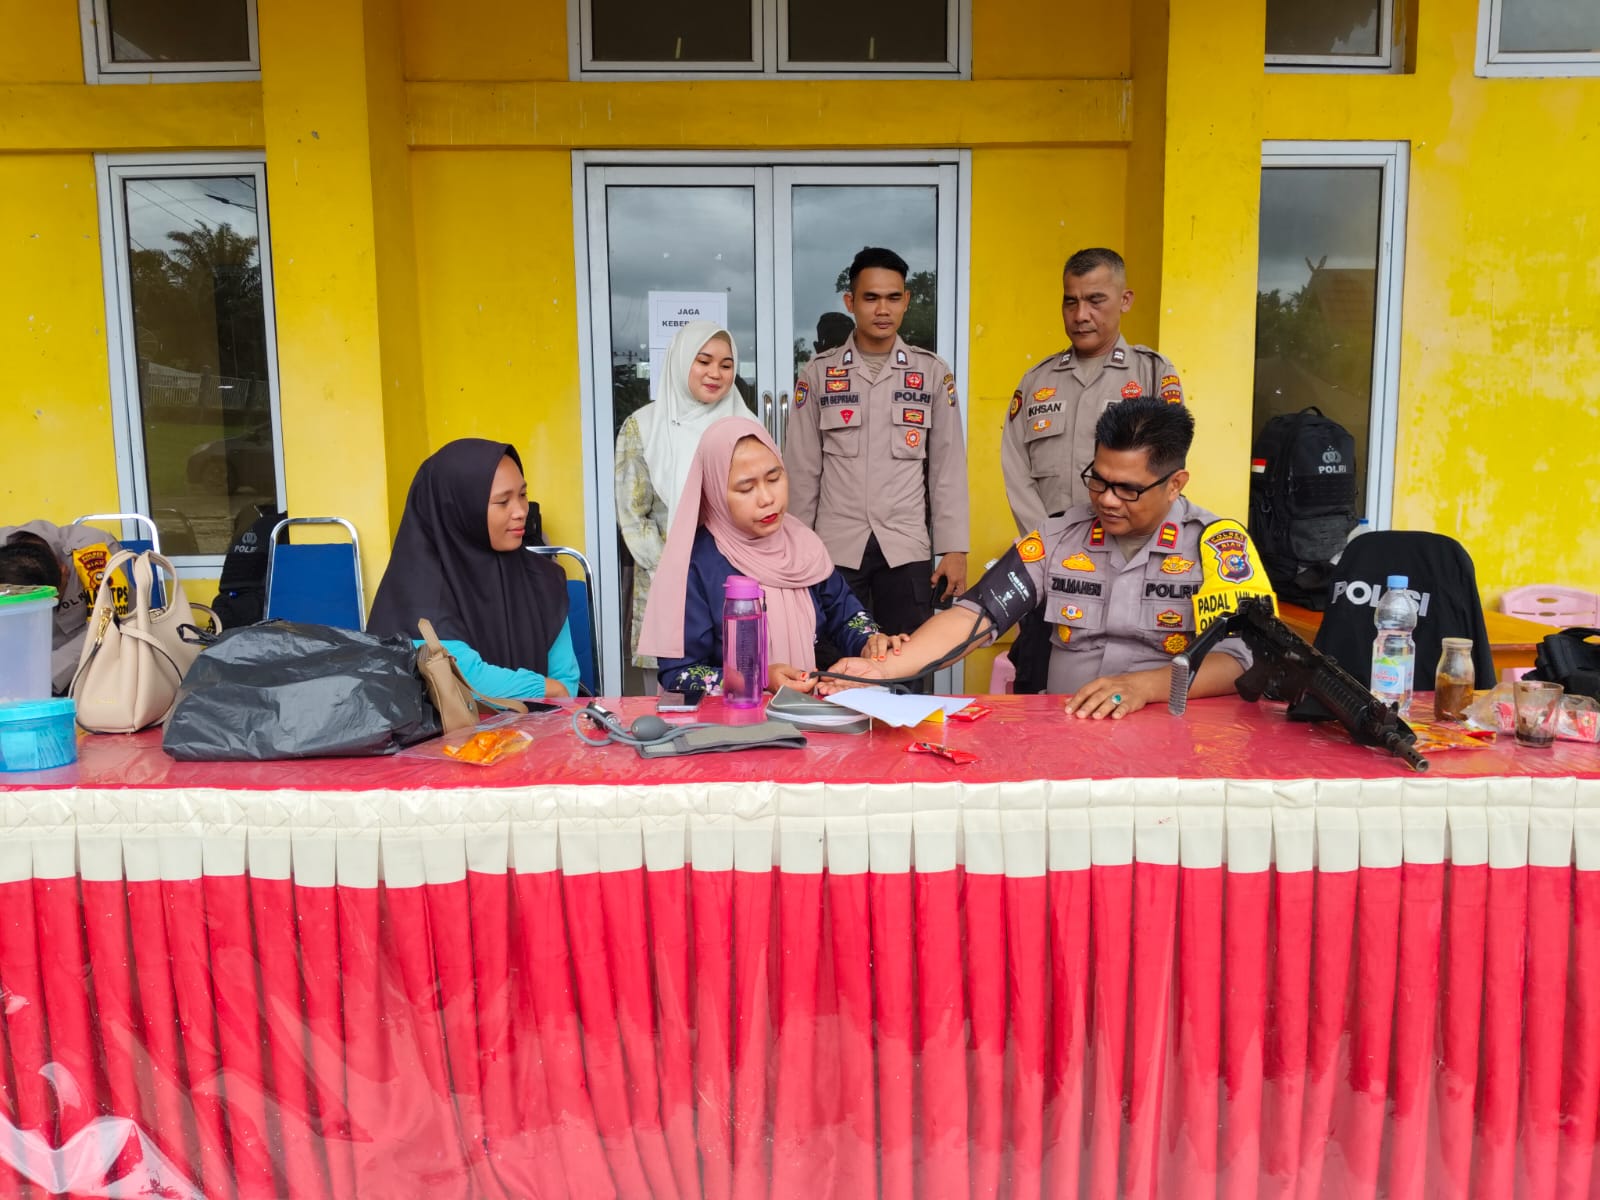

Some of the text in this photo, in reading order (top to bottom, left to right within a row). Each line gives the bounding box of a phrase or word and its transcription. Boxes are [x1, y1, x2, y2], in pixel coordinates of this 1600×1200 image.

[677, 308, 700, 316] JAGA
[894, 391, 931, 404] POLRI
[1318, 465, 1347, 474] POLRI
[1145, 582, 1199, 599] POLRI
[1198, 593, 1230, 616] PADAL
[1331, 580, 1431, 617] POLSI
